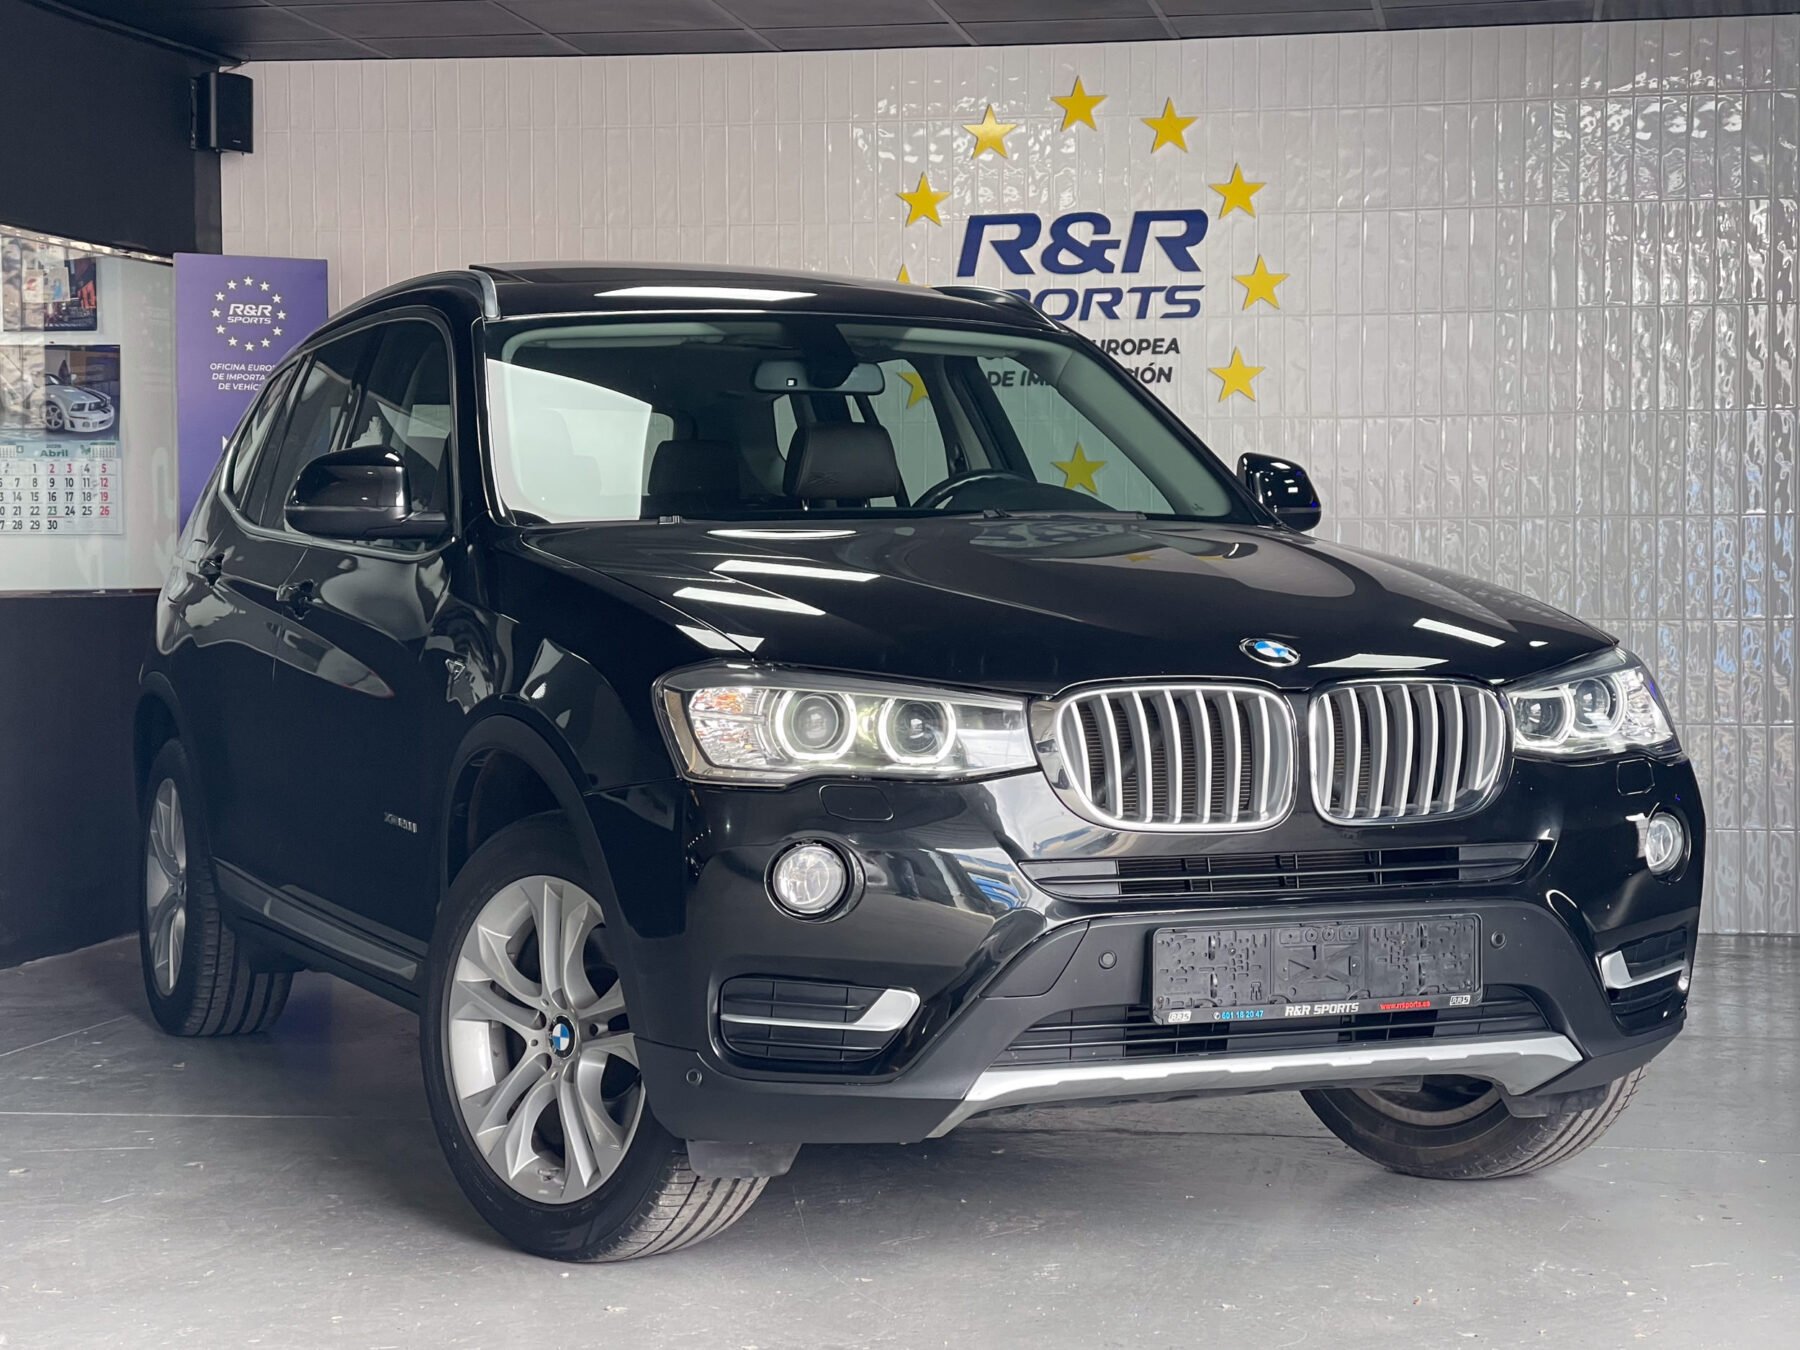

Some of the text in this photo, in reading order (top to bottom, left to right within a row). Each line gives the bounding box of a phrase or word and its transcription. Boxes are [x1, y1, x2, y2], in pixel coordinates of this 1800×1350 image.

[957, 209, 1209, 277] R&R
[1003, 284, 1206, 322] ORTS
[228, 303, 272, 317] R&R
[227, 316, 272, 324] SPORTS
[1092, 337, 1180, 356] ROPEA
[210, 362, 276, 372] OFICINA EURO
[212, 373, 266, 381] DE IMPORTA
[987, 370, 1016, 387] DE
[218, 382, 262, 391] DE VEHÍC
[40, 449, 68, 458] Abril
[33, 463, 107, 473] 1 2 3 4 5
[15, 478, 108, 487] 7 8 9 10 11 12
[13, 492, 22, 501] 14
[30, 492, 39, 501] 15
[48, 492, 57, 501] 16
[65, 492, 74, 501] 17
[82, 492, 92, 501] 18
[100, 492, 108, 501] 19
[13, 506, 22, 515] 21
[30, 506, 40, 515] 22
[48, 506, 57, 515] 23
[65, 506, 75, 515] 24
[82, 506, 92, 515] 25
[100, 506, 110, 515] 26
[12, 520, 22, 529] 28
[30, 520, 40, 529] 29
[47, 520, 57, 529] 30
[1284, 1002, 1360, 1017] R&R SPORTS
[1221, 1011, 1234, 1019] 601
[1246, 1010, 1254, 1018] 20
